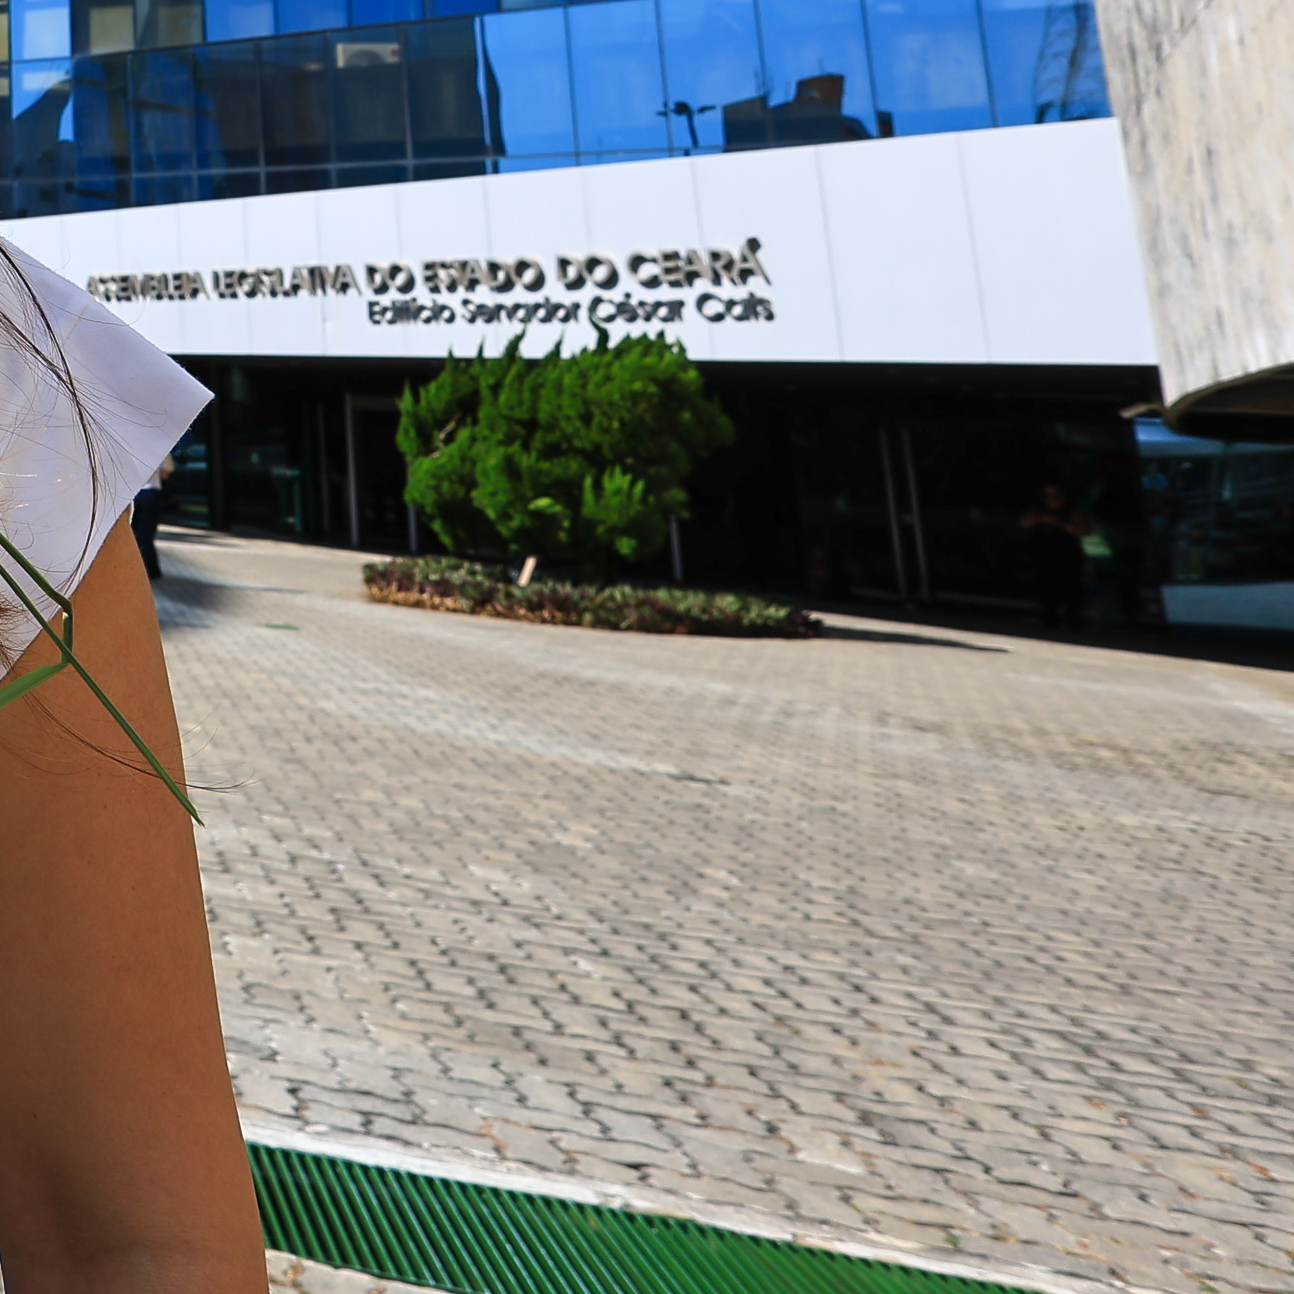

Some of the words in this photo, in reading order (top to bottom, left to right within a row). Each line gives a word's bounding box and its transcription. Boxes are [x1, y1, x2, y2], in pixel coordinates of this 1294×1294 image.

[86, 269, 209, 303] ASSEMBLEIA
[212, 263, 362, 300] LEGISLATIVA
[365, 262, 416, 295] DO
[422, 257, 546, 294] ESTADO
[557, 254, 619, 291] DO
[627, 237, 772, 290] CEARÁ
[461, 297, 581, 324] Senador
[588, 292, 685, 324] César
[696, 291, 775, 323] Cals
